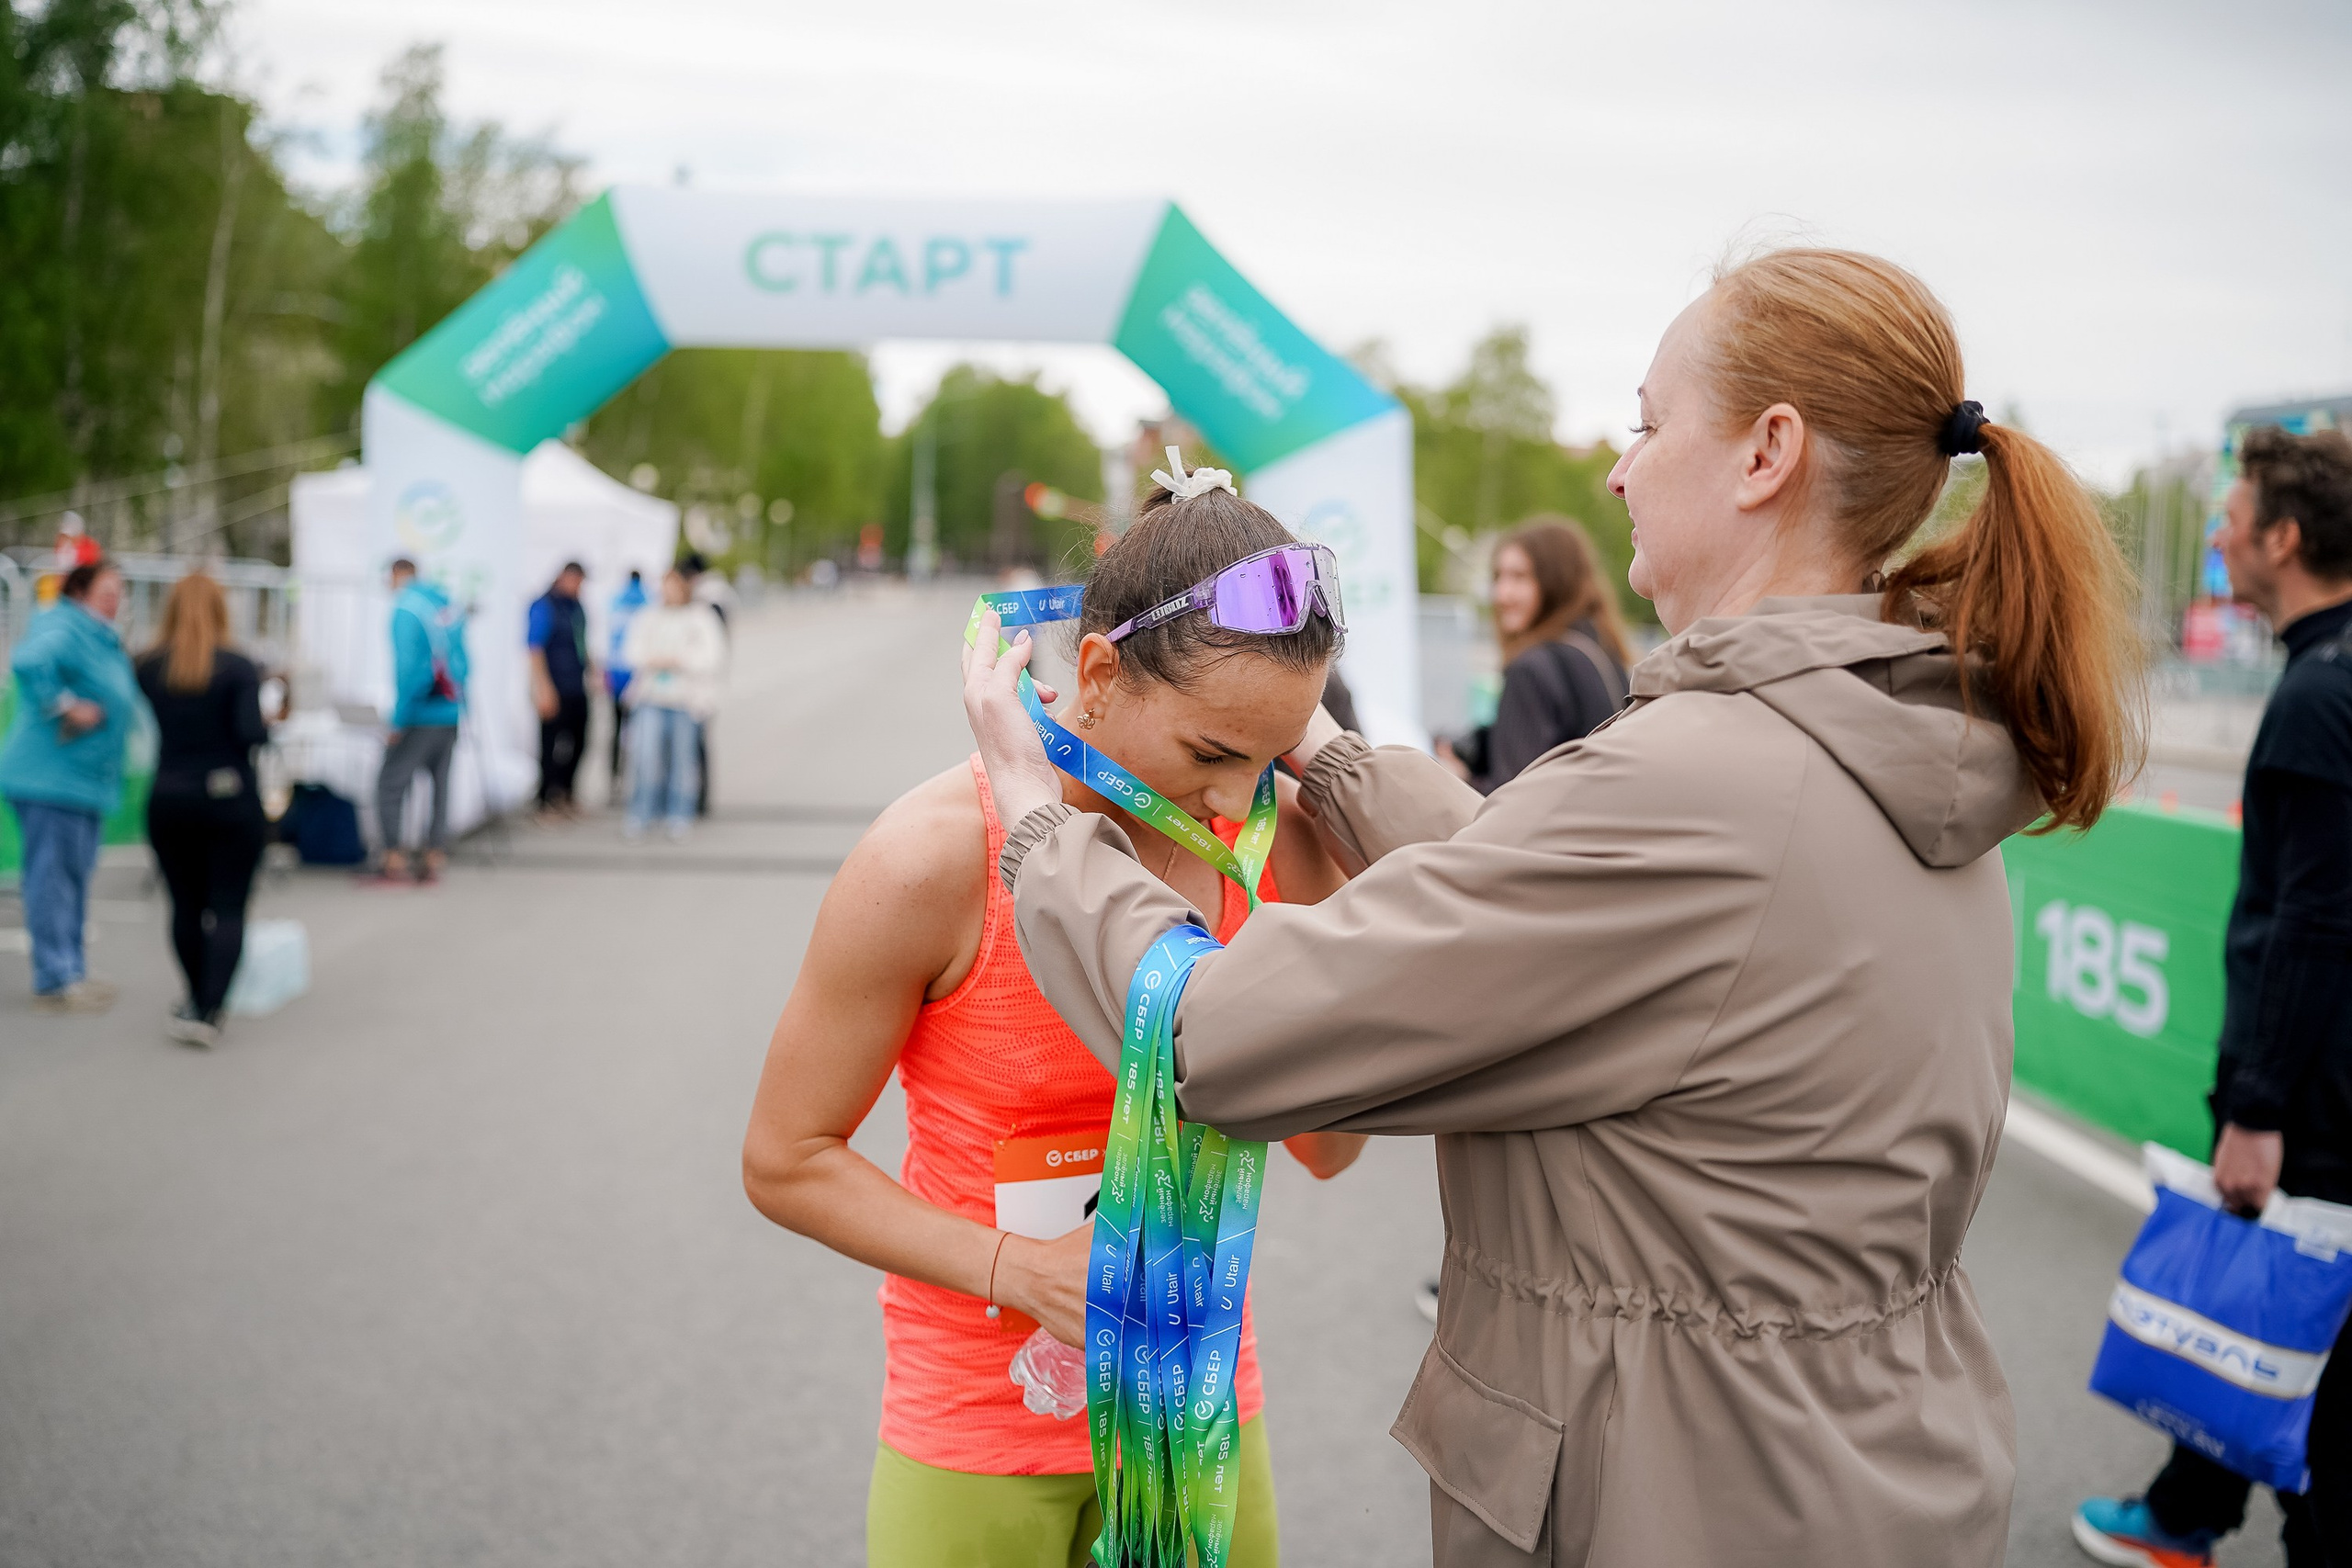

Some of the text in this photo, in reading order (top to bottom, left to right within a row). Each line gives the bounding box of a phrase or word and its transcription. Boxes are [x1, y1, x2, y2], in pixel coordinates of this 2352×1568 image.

[743, 228, 1033, 298] СТАРТ
[997, 603, 1019, 615] СБЕР
[1049, 599, 1065, 611] Utair
[1034, 719, 1056, 745] Utair
[1097, 770, 1134, 796] СБЕР
[1165, 815, 1211, 852] 185 лет
[1250, 817, 1267, 845] 185 лет
[2036, 899, 2169, 1038] 185
[1134, 993, 1150, 1040] СБЕР
[1123, 1061, 1138, 1124] 185 лет
[1064, 1148, 1099, 1163] СБЕР
[1203, 1163, 1216, 1201] марафон
[1209, 1169, 1223, 1205] зелёный
[1236, 1168, 1246, 1204] зелёный
[1242, 1172, 1252, 1210] марафон
[1157, 1188, 1167, 1224] зелёный
[1166, 1190, 1174, 1227] марафон
[1102, 1264, 1115, 1294] Utair
[1166, 1272, 1180, 1304] Utair
[1225, 1254, 1240, 1288] Utair
[1193, 1276, 1204, 1307] Utair
[1099, 1350, 1112, 1393] СБЕР
[1172, 1364, 1186, 1408] СБЕР
[1202, 1349, 1222, 1396] СБЕР
[1137, 1369, 1150, 1415] СБЕР
[1099, 1411, 1107, 1438] 185
[1142, 1435, 1154, 1461] 185
[1214, 1433, 1231, 1494] 185 лет
